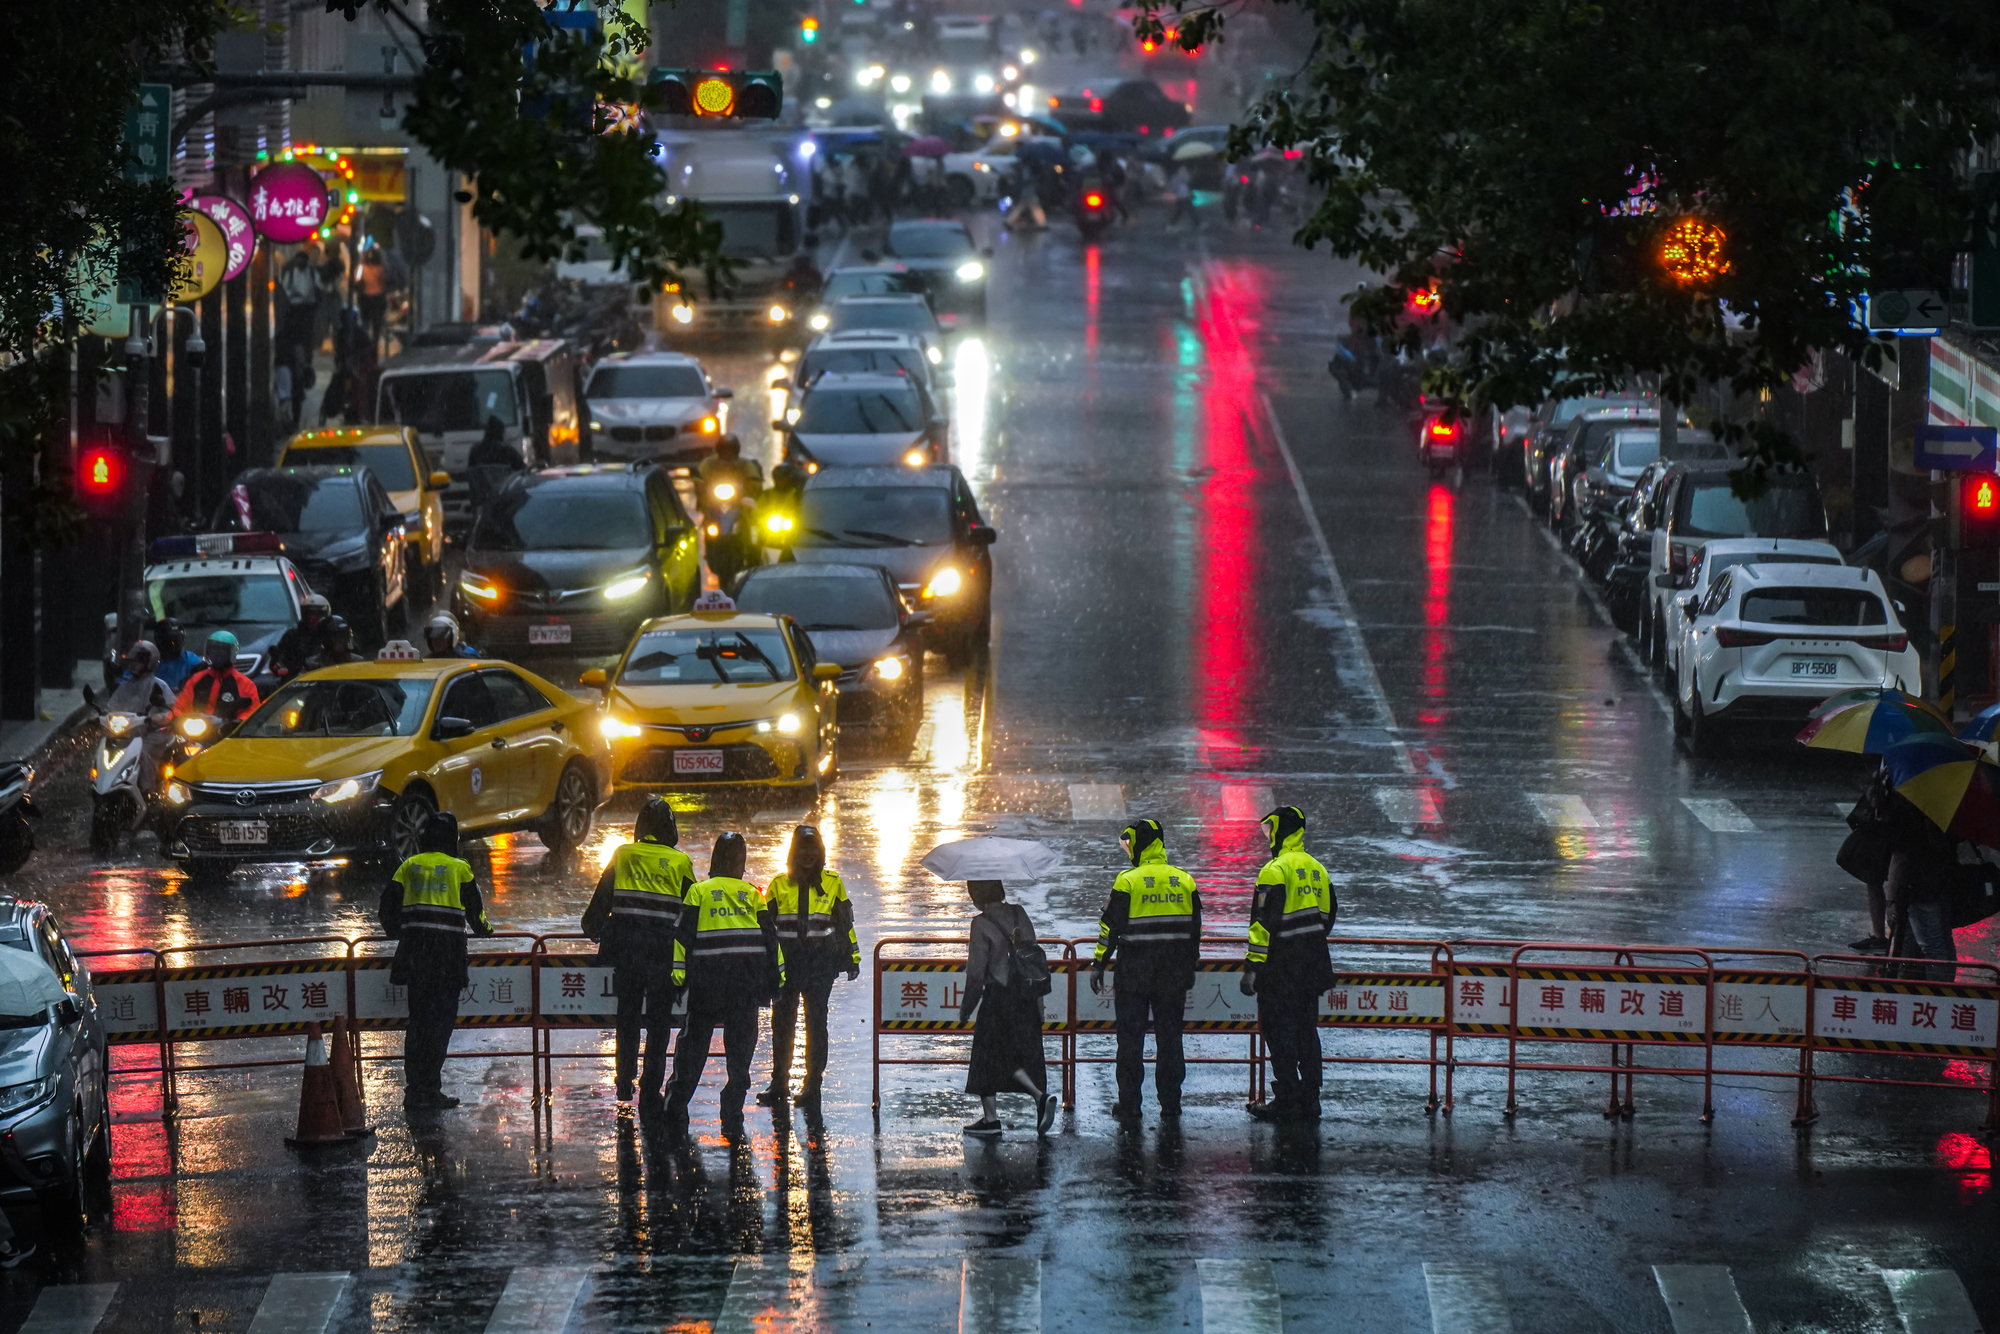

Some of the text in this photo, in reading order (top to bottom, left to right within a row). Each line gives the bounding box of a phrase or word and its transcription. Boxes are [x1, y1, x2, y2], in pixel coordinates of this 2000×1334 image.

[1792, 662, 1837, 675] BPY-5508
[675, 756, 723, 770] TDS-9062
[220, 826, 267, 841] TDB-1575
[1143, 875, 1181, 889] 警察
[1295, 868, 1321, 882] 警察
[711, 889, 749, 902] 警察
[1141, 893, 1184, 904] POLICE
[184, 981, 329, 1016] 車輛改道
[1540, 985, 1685, 1016] 車輛改道
[1832, 995, 1977, 1031] 車輛改道
